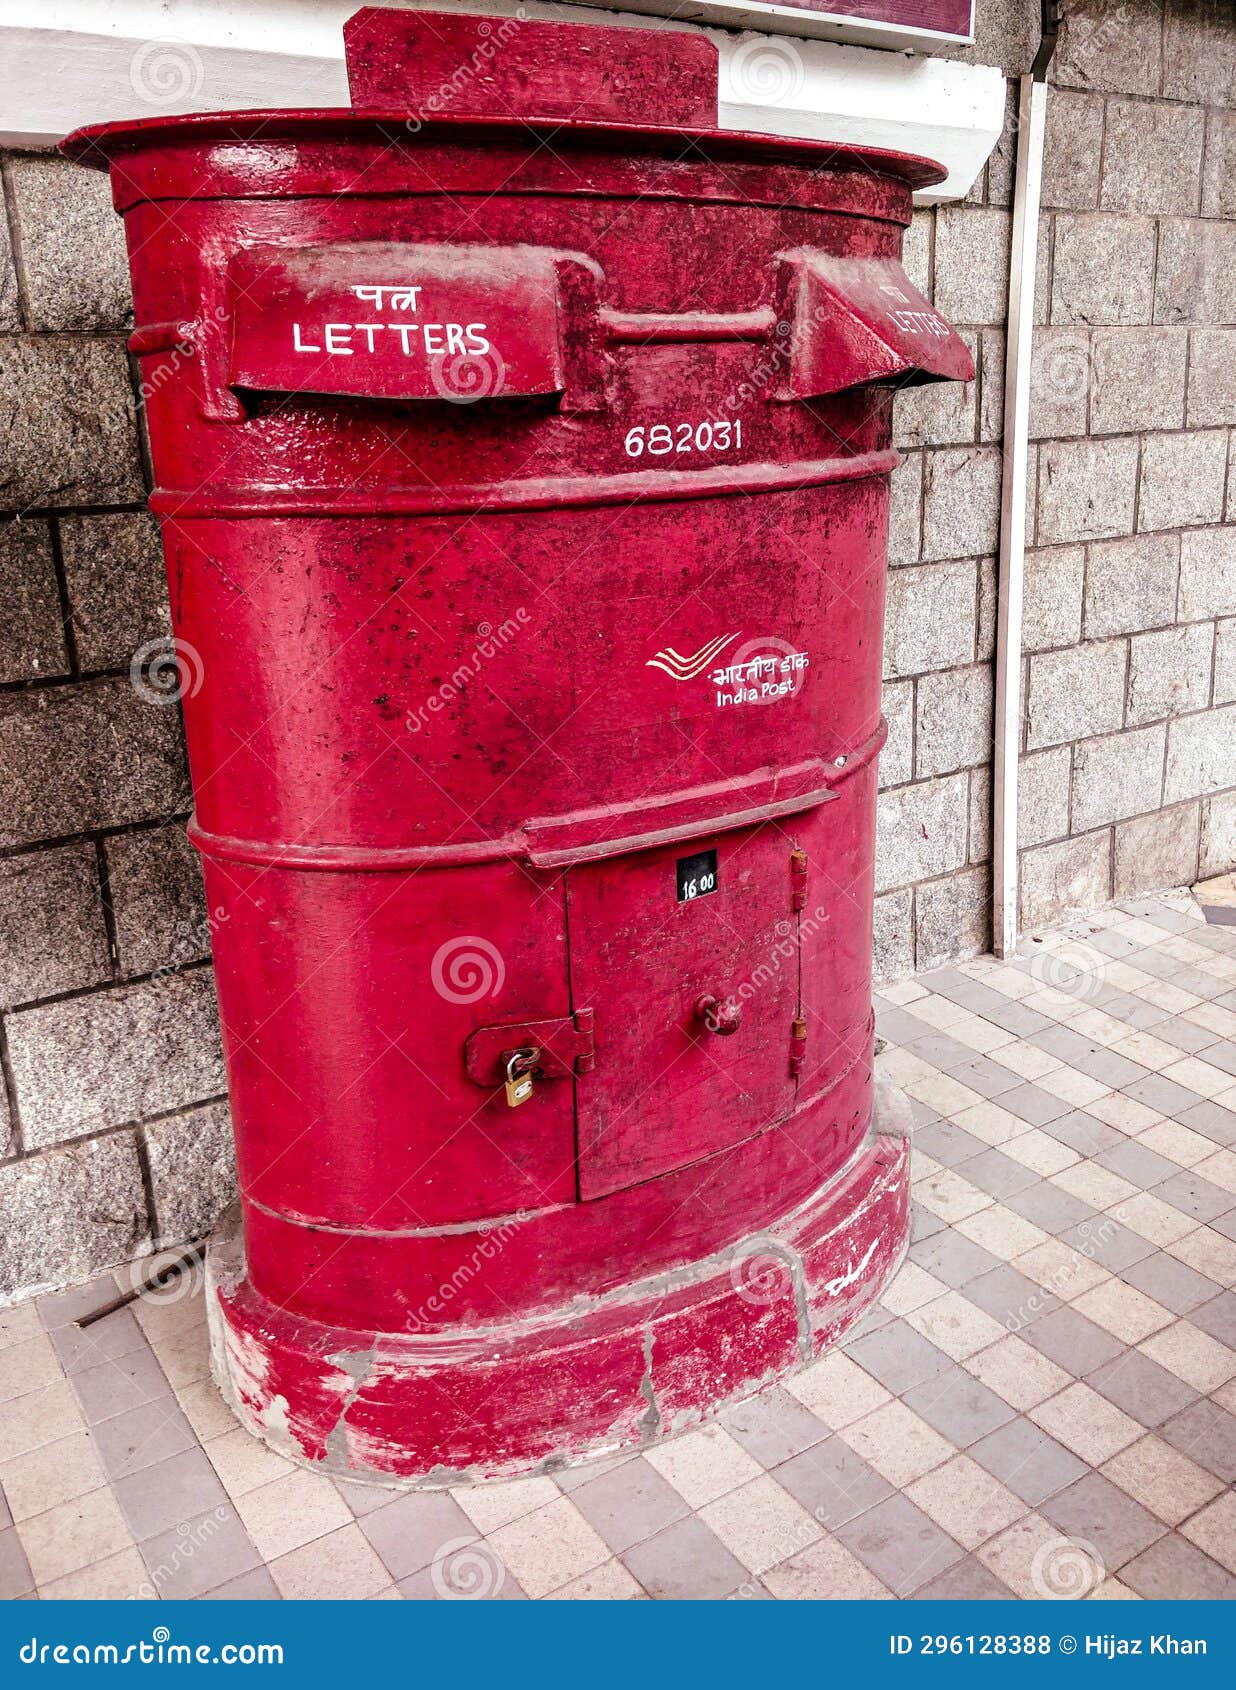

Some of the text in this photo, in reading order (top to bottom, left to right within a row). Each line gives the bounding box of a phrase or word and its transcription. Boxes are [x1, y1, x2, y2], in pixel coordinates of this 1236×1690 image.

[293, 323, 490, 356] LETTERS
[624, 419, 742, 457] 682031
[712, 651, 809, 686] भारतीय डाक
[716, 679, 796, 707] India Post
